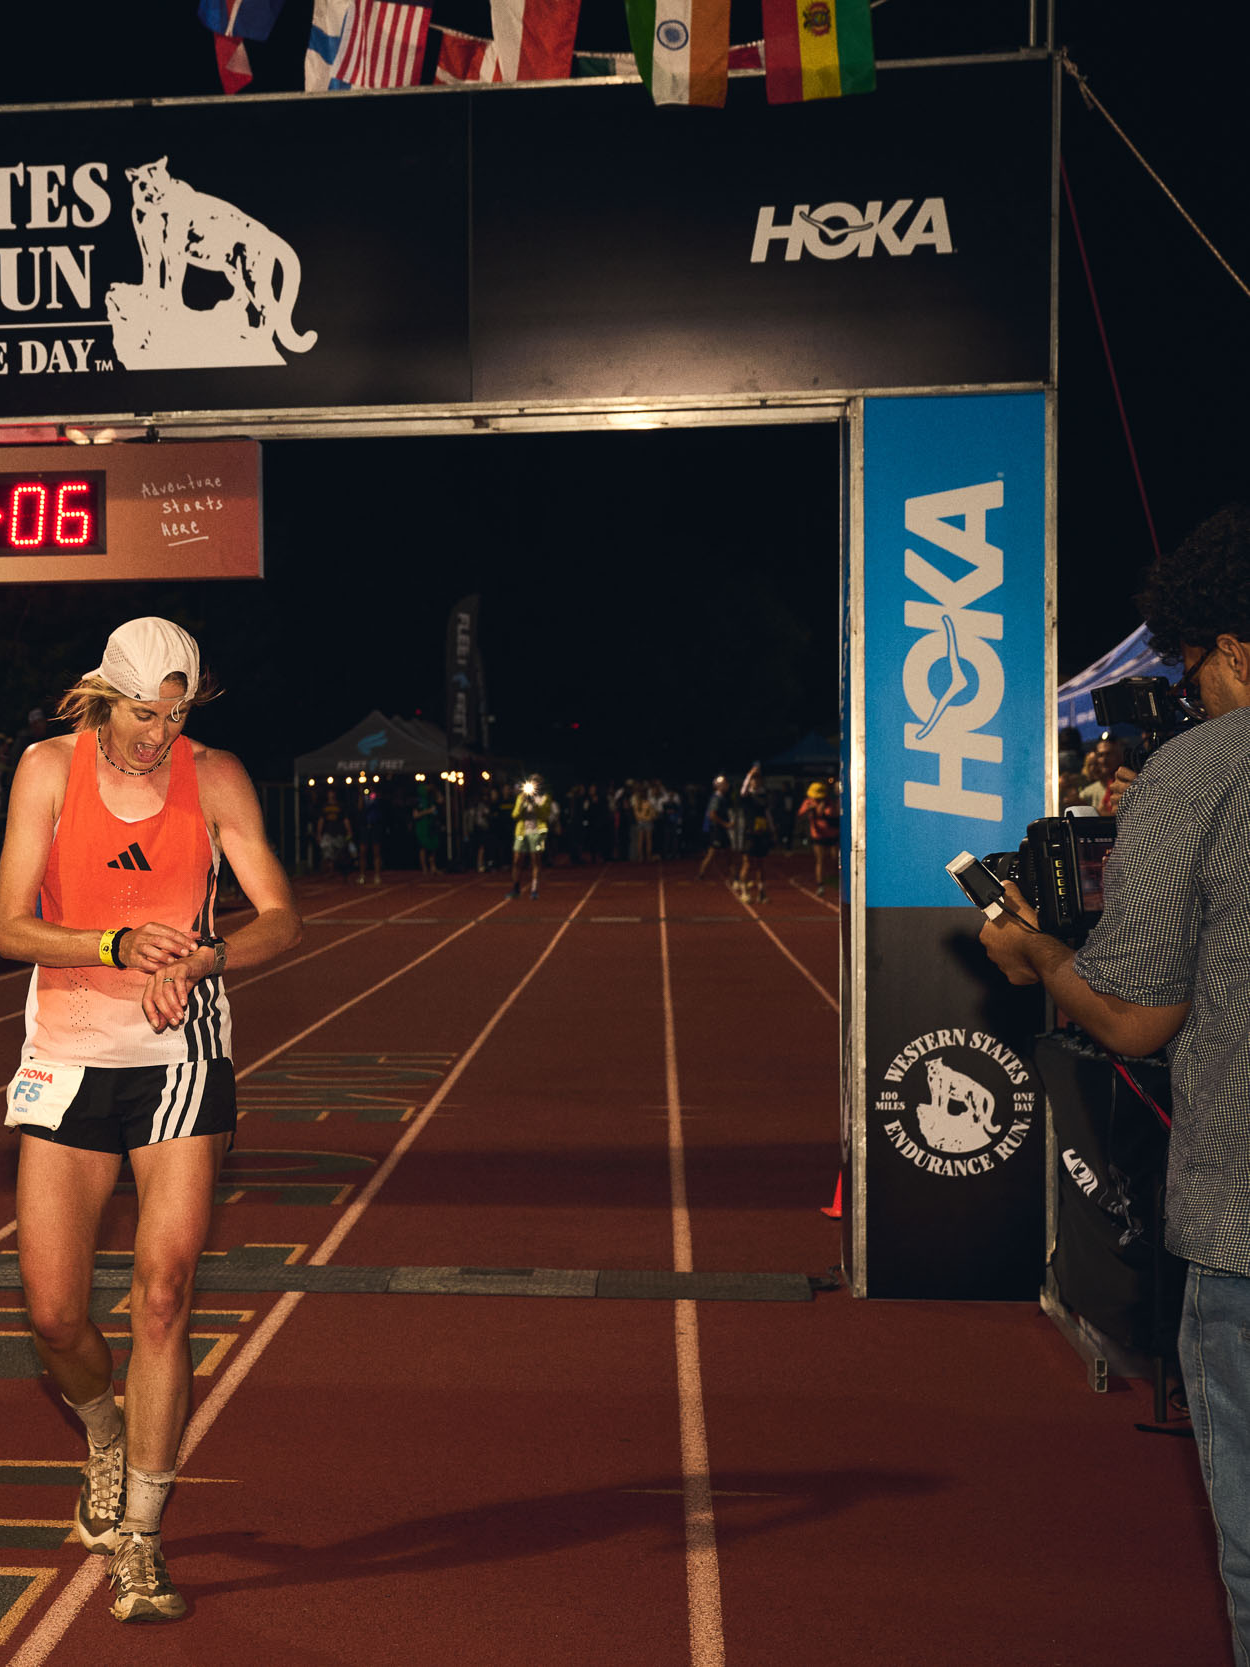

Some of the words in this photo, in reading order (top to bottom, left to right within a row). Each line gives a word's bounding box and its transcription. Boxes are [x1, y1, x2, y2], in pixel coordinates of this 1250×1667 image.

[750, 196, 953, 264] HOKA
[18, 338, 95, 374] DAY
[903, 479, 1005, 823] HOKA
[884, 1028, 967, 1083] WESTERN
[969, 1031, 1030, 1085] STATES
[17, 1067, 54, 1084] FIONA
[13, 1080, 44, 1103] F5
[880, 1091, 899, 1101] 100
[1012, 1092, 1035, 1102] ONE
[875, 1101, 906, 1111] MILES
[1013, 1102, 1035, 1112] DAY
[883, 1119, 995, 1177] ENDURANCE
[993, 1119, 1031, 1162] RUN
